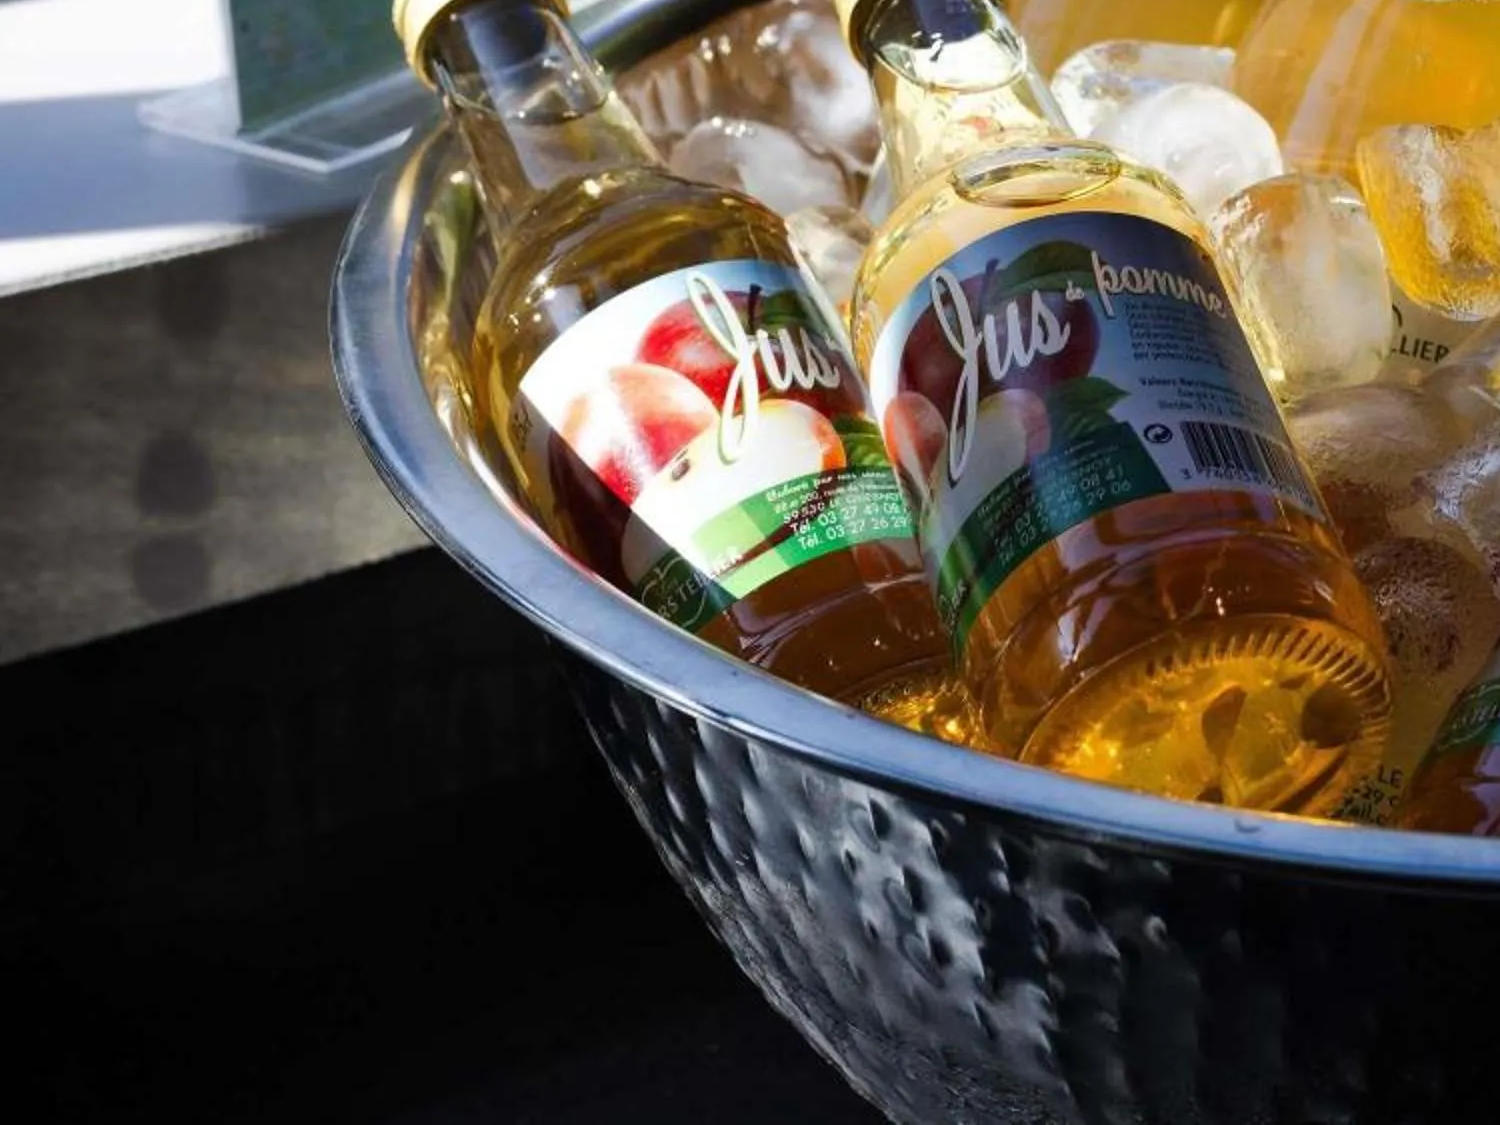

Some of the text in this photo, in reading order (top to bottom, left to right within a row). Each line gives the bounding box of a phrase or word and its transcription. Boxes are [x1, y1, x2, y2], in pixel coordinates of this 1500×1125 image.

[1392, 334, 1450, 364] LIER
[686, 275, 841, 465] Jus
[931, 268, 1070, 484] Jus
[1065, 279, 1085, 302] de
[818, 511, 837, 527] 03
[826, 525, 845, 541] 03
